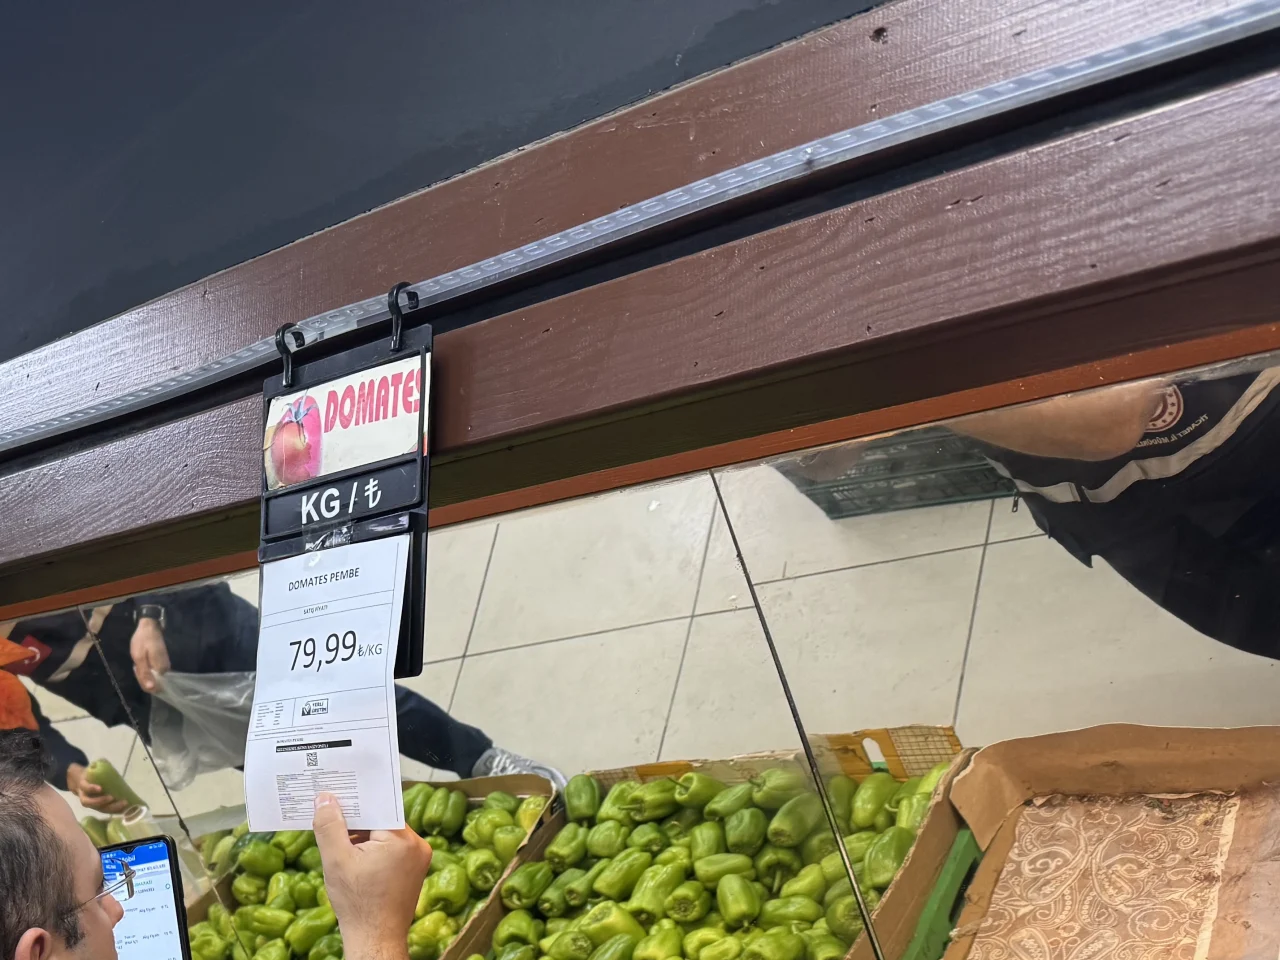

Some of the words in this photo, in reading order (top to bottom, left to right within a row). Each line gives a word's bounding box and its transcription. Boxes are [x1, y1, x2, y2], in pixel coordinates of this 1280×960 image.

[301, 487, 340, 525] KG
[288, 574, 328, 591] DOMATES
[330, 567, 360, 582] PEMBE
